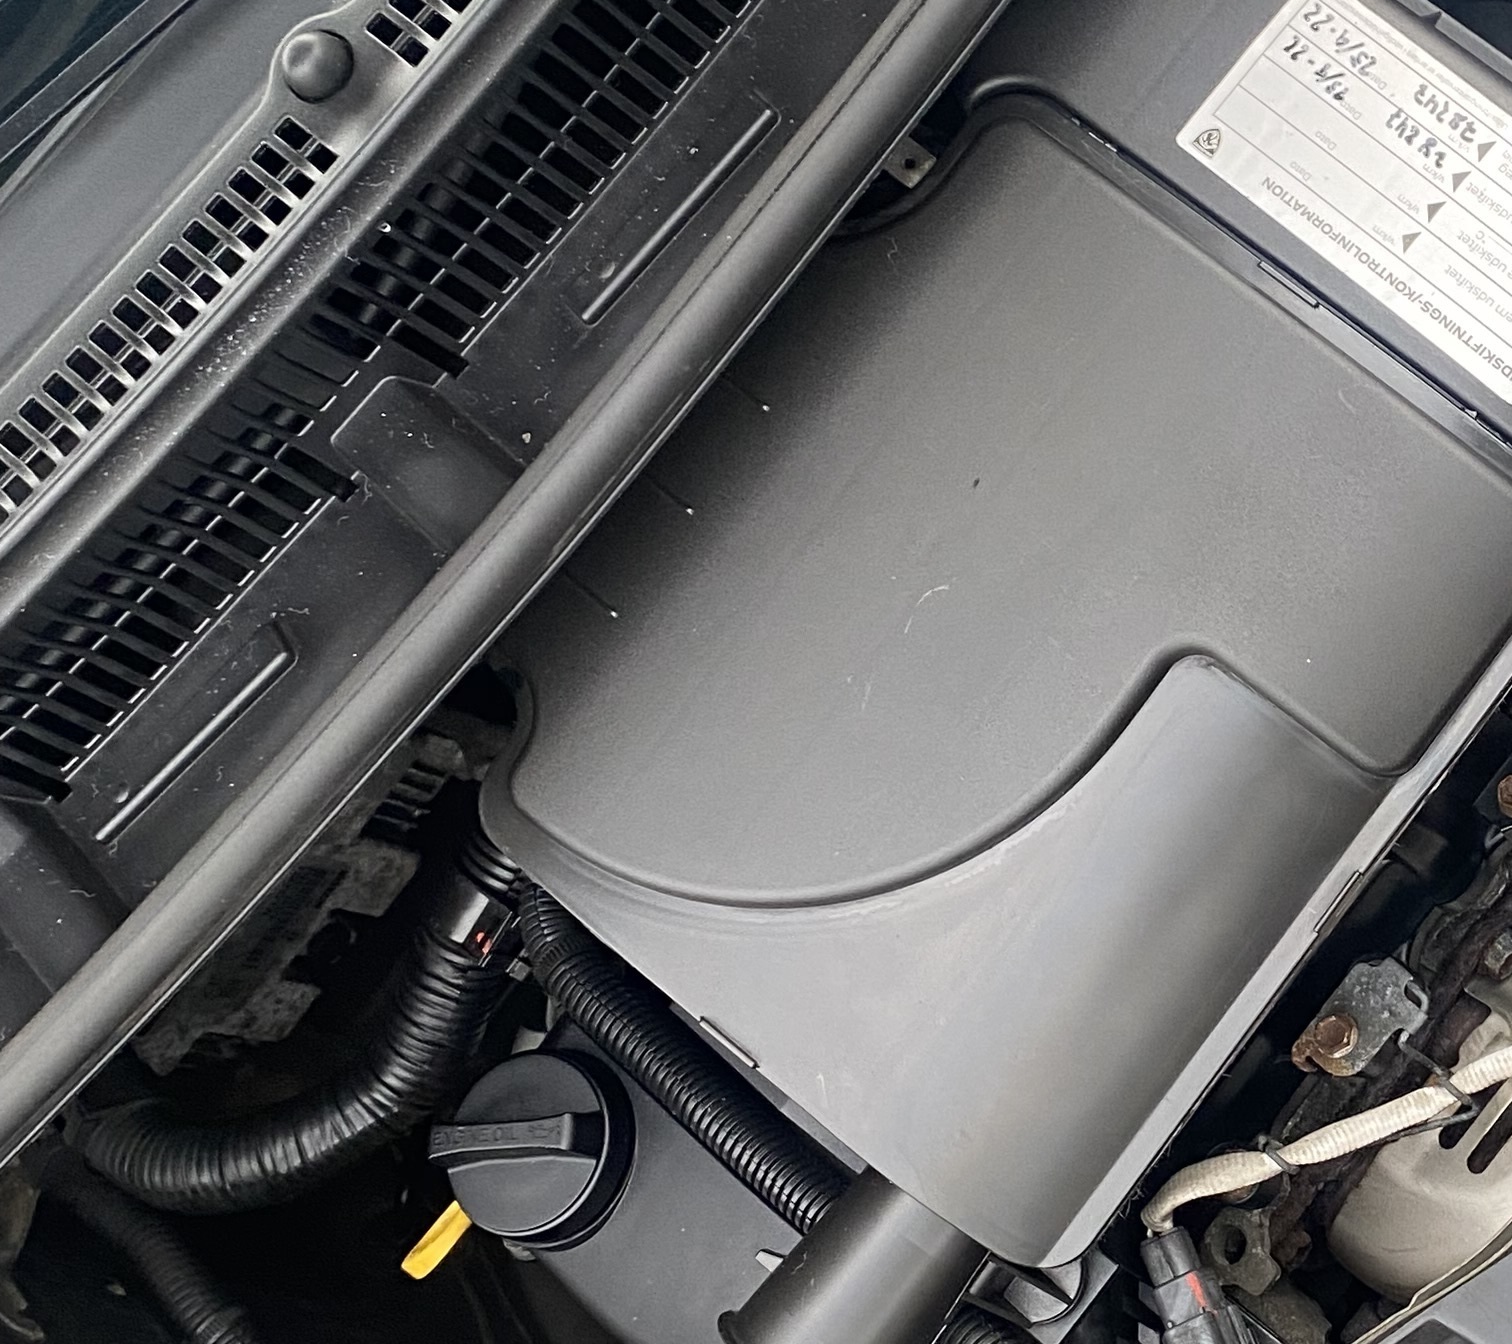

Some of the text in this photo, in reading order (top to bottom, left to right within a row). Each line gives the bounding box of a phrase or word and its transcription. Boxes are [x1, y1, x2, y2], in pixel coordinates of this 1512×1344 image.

[1312, 128, 1338, 151] Dato
[1287, 159, 1313, 182] Dato
[1452, 228, 1508, 275] udskiftet
[1440, 263, 1496, 310] udskiftet
